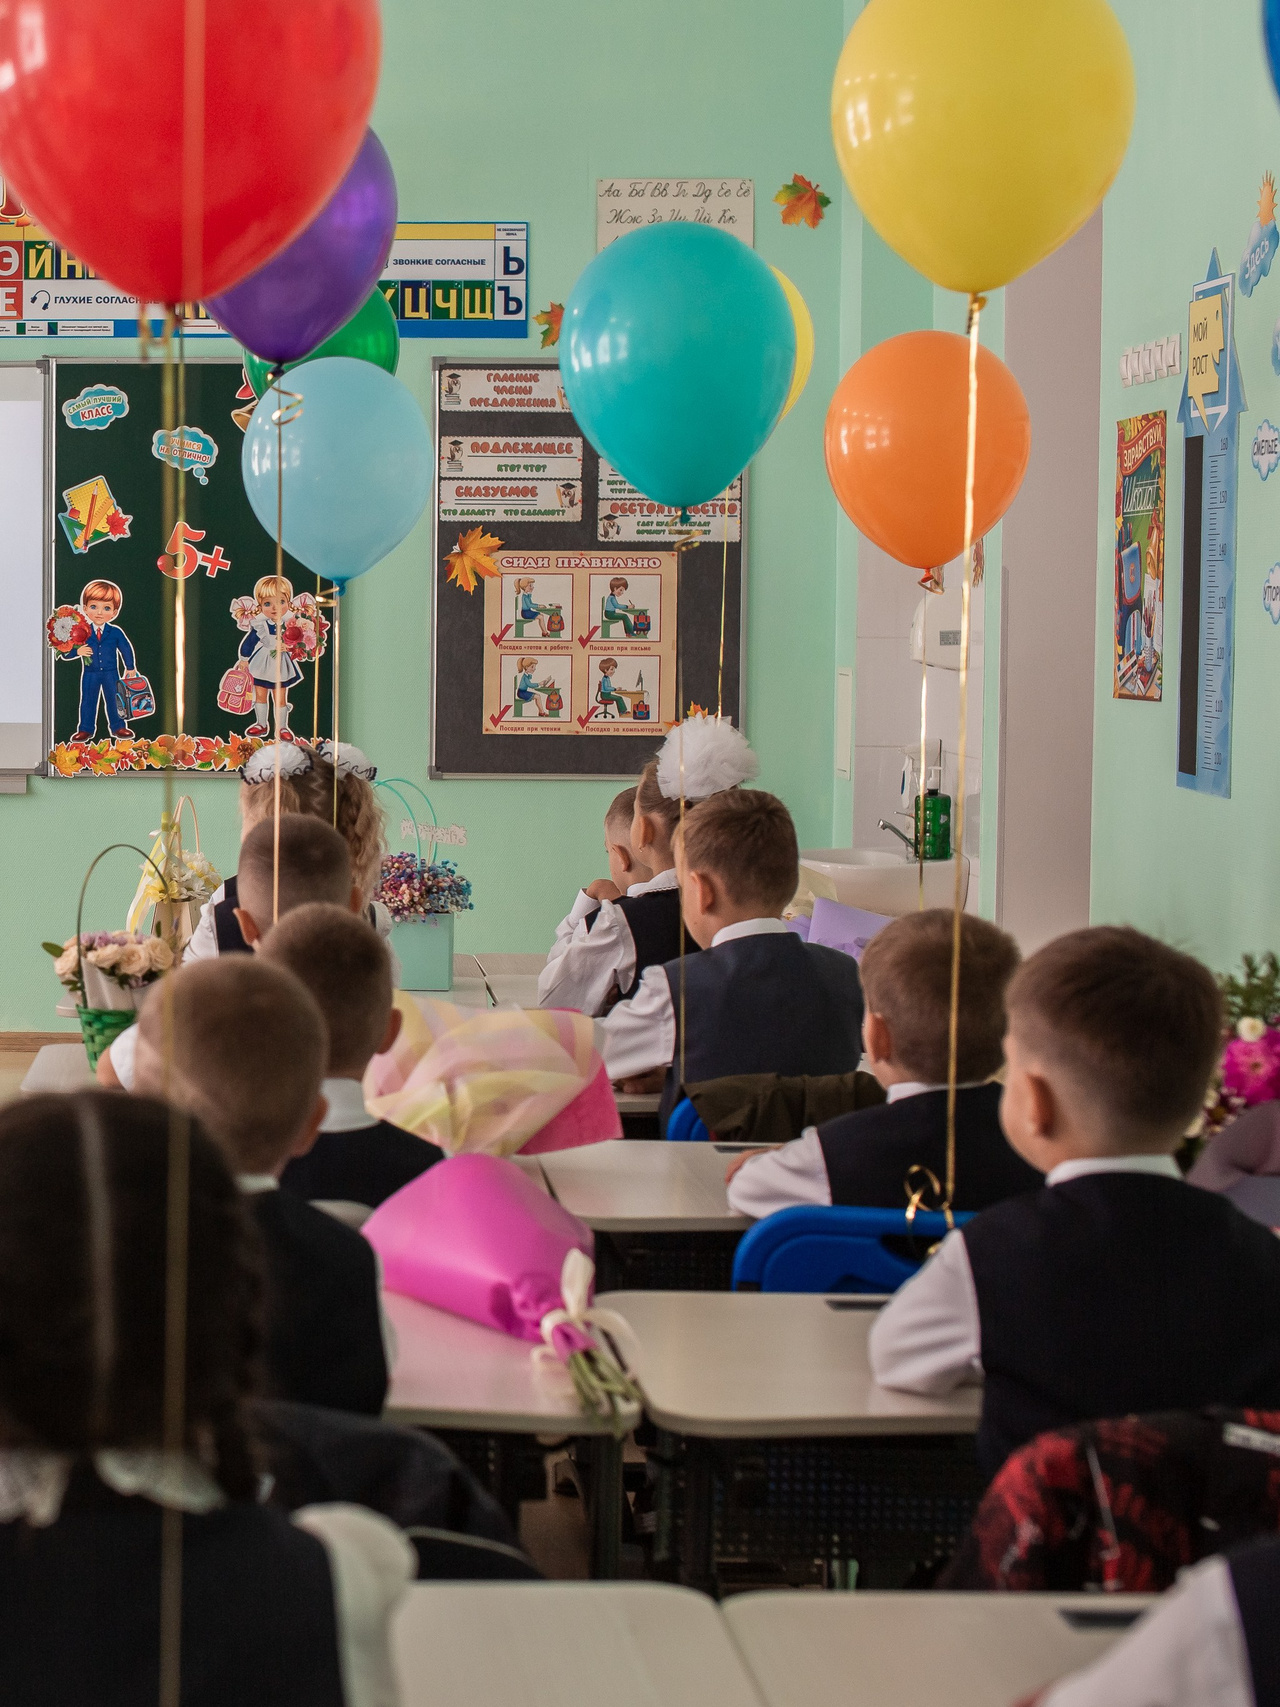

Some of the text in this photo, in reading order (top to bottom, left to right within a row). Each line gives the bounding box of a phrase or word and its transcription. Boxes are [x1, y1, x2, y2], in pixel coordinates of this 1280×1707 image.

[393, 258, 486, 266] ЗВОНКИЕ СОГЛАСНЫЕ
[54, 296, 93, 305] ГЛУХИЕ
[1193, 318, 1208, 342] МОЙ
[1192, 354, 1208, 376] РОСТ
[486, 372, 540, 383] ГЛАВНЫЕ
[493, 385, 533, 395] ЧЛЕНЫ
[67, 396, 122, 415] САМЫЙ ЛУЧШИЙ
[469, 397, 557, 408] ПРЕДЛОЖЕНИЯ
[80, 405, 113, 421] КЛАСС
[470, 441, 574, 455] ПОДЛЕЖАЩЕЕ
[497, 464, 547, 473] КТО? ЧТО?
[455, 485, 539, 498] СКАЗУЕМОЕ
[501, 556, 661, 569] СИДИ ПРАВИЛЬНО
[499, 725, 525, 733] Посадка
